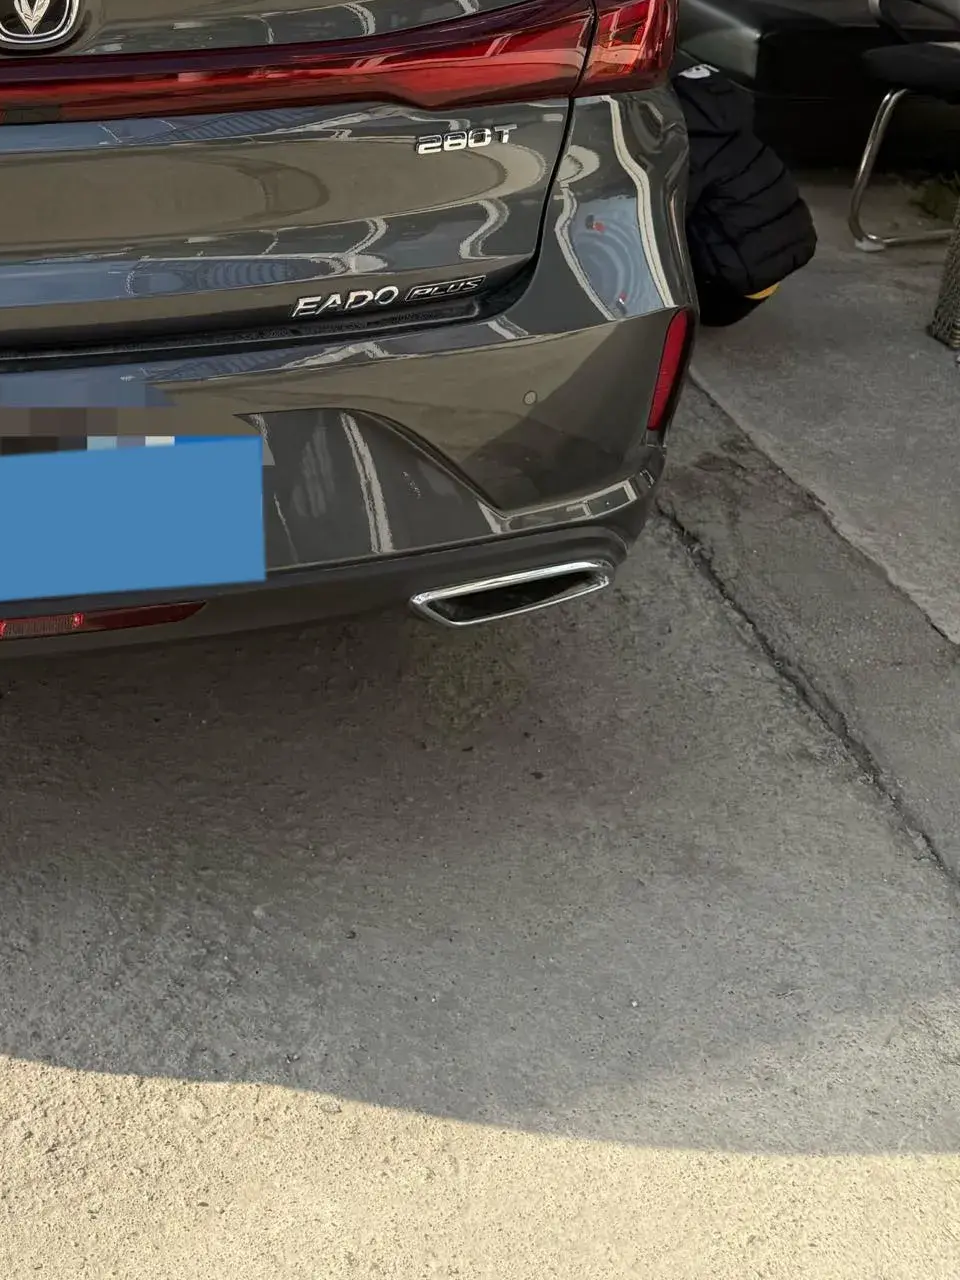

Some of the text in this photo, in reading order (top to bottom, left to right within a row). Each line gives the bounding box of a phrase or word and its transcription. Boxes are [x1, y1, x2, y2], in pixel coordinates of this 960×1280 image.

[416, 123, 518, 154] 280T
[292, 276, 484, 317] EADO PLUS
